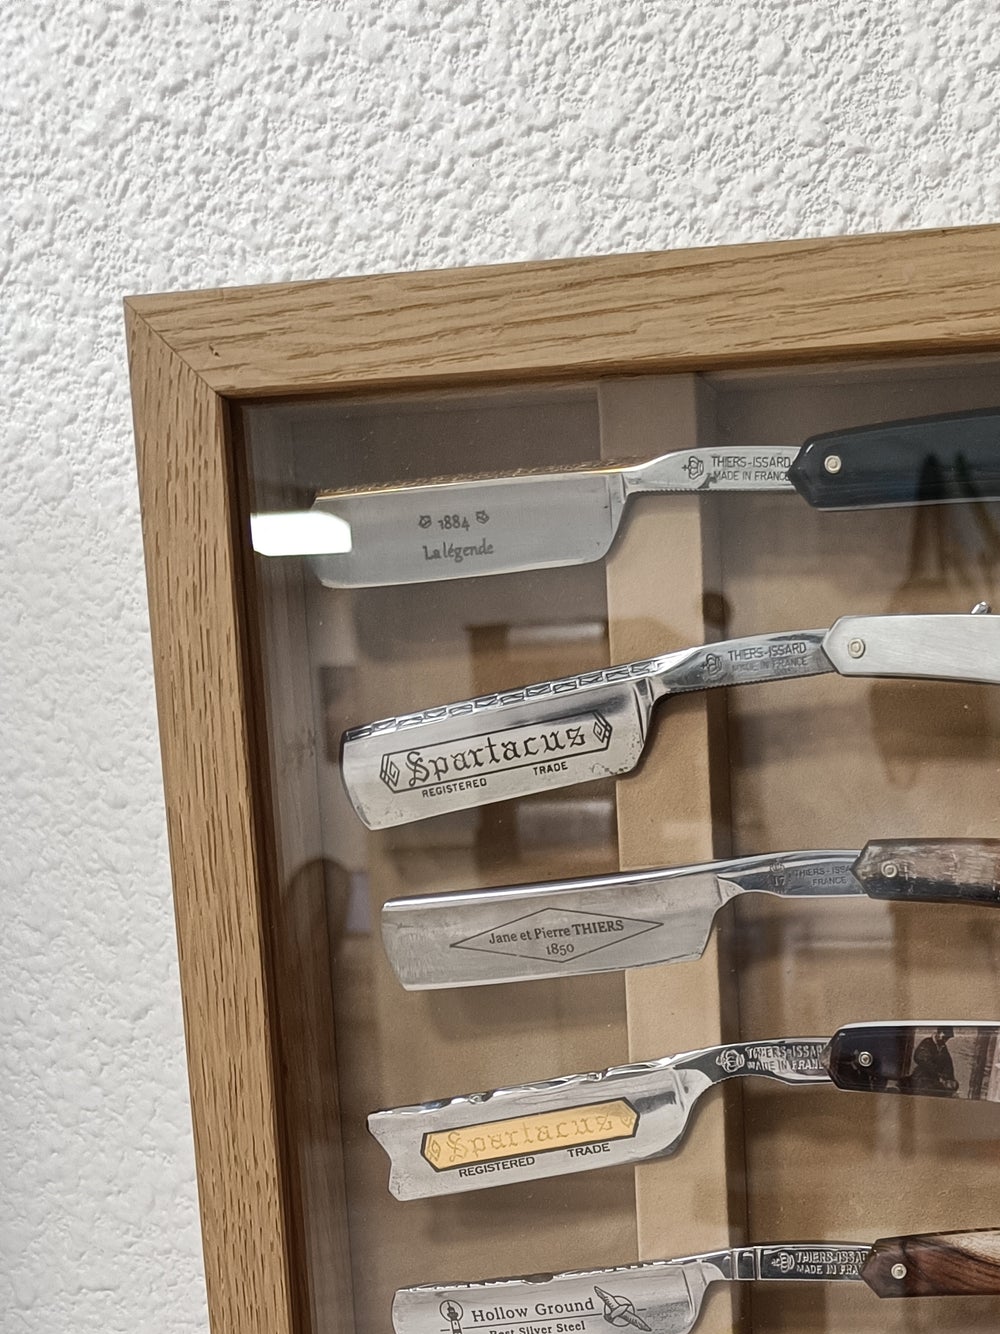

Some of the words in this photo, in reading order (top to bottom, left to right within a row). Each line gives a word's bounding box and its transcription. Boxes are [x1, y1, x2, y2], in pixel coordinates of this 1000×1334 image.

[711, 455, 791, 468] THIERS-ISSARD
[713, 470, 739, 481] MADE
[742, 470, 751, 480] IN
[437, 514, 470, 531] 1884
[422, 545, 441, 560] La
[442, 538, 494, 563] légende
[728, 642, 807, 661] THIERS-ISSARD
[405, 726, 586, 787] Spartacus
[421, 778, 487, 798] REGISTERED
[533, 762, 568, 776] TRADE
[795, 865, 852, 876] THIERS-ISSA
[489, 933, 517, 944] Jane
[520, 930, 532, 941] et
[534, 926, 571, 940] Pierre
[572, 919, 624, 936] THIERS
[546, 943, 574, 956] 1850
[745, 1045, 827, 1060] THIERS-ISSAR
[446, 1114, 614, 1163] Spartacus
[459, 1156, 535, 1178] REGISTERED
[567, 1143, 610, 1158] TRADE
[797, 1265, 823, 1275] MADE
[826, 1265, 837, 1275] IN
[471, 1307, 528, 1322] Hollow
[534, 1298, 595, 1316] Ground
[556, 1320, 586, 1334] Steel
